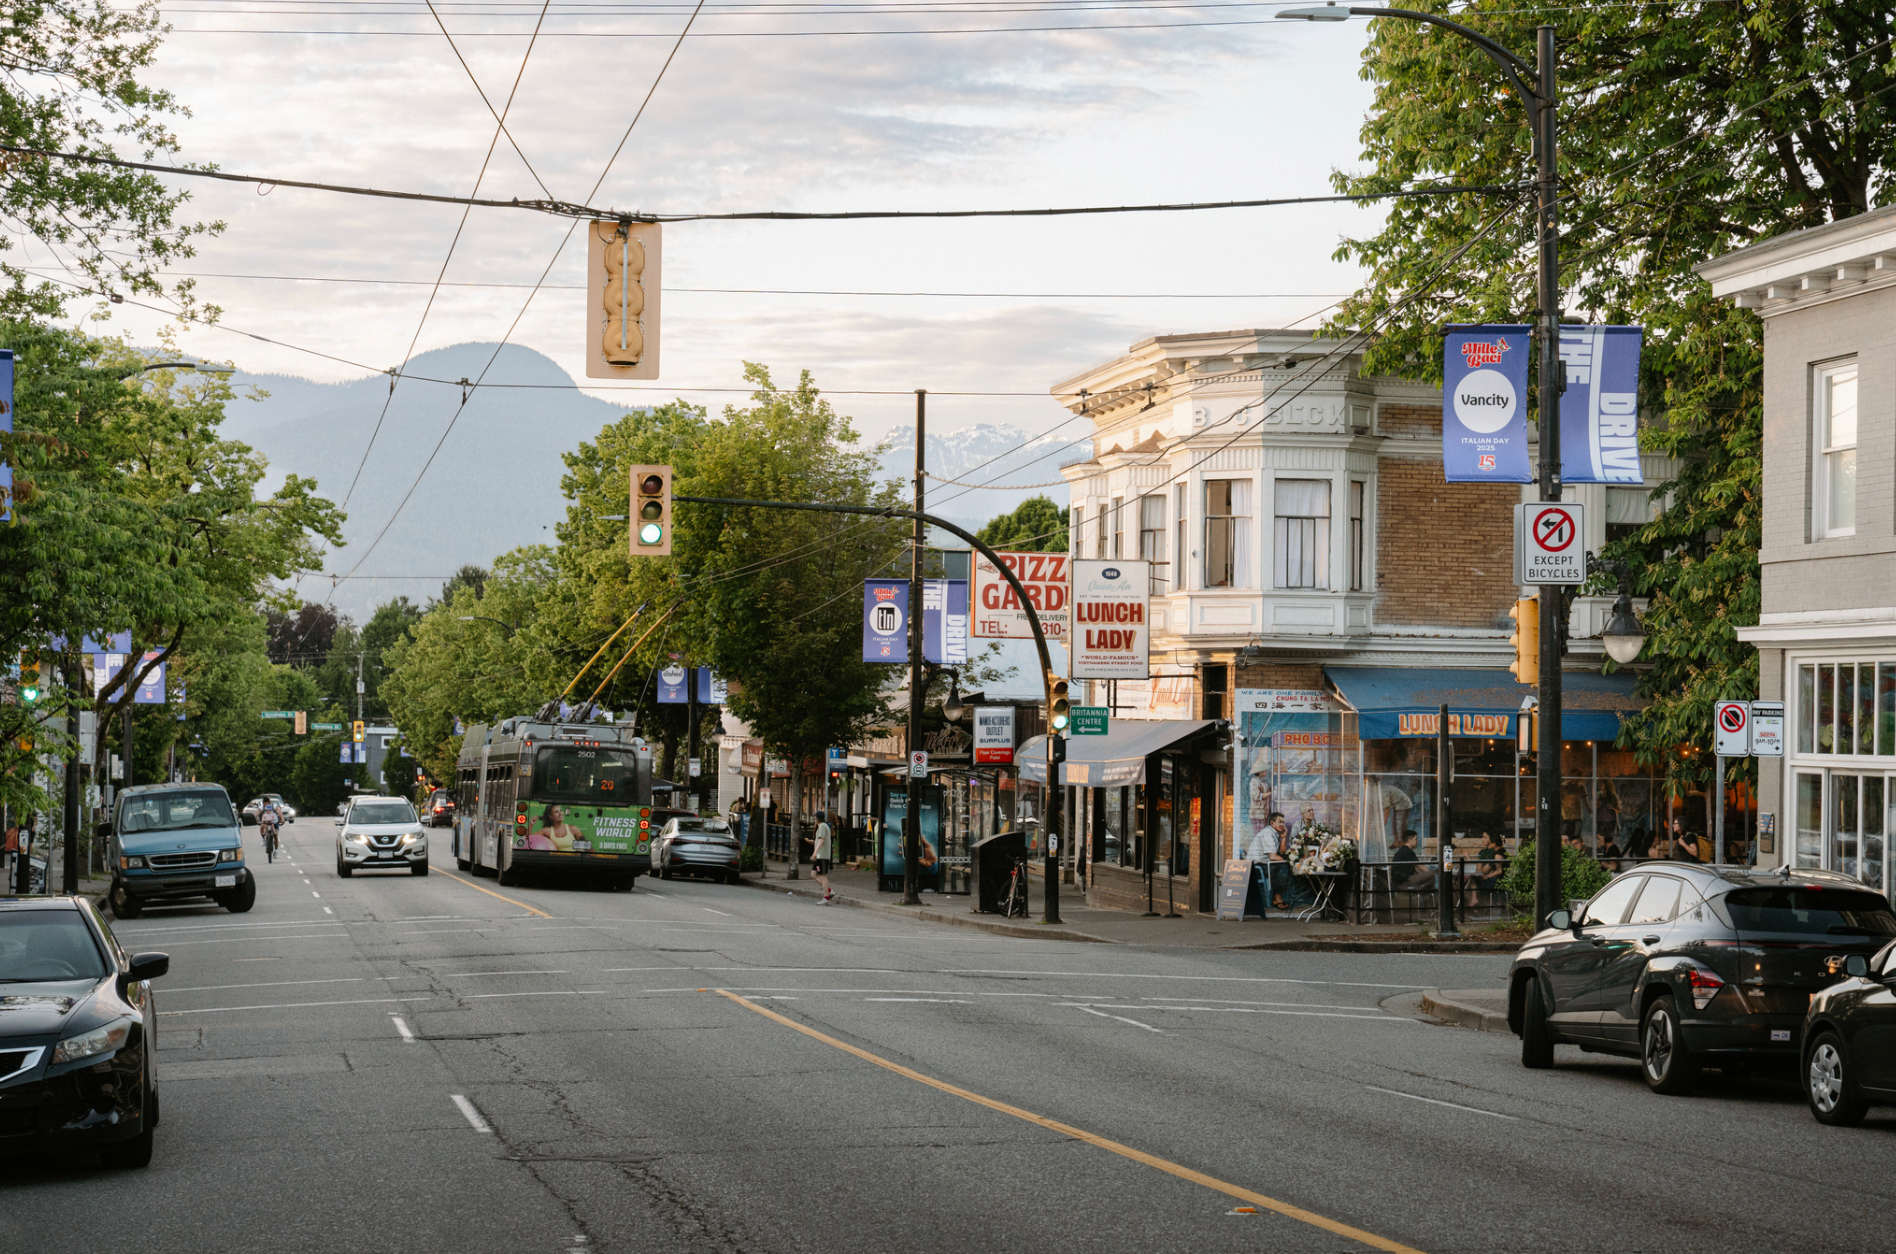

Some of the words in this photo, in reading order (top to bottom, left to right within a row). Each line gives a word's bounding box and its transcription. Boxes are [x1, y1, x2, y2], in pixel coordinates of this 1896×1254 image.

[1462, 342, 1498, 354] Mille
[1467, 352, 1502, 368] Baci
[1461, 394, 1508, 408] Vancity
[1600, 393, 1640, 481] DRIVE
[1534, 556, 1574, 565] EXCEPT
[999, 555, 1069, 582] PIZZ
[1529, 569, 1579, 578] BICYCLES
[1077, 602, 1145, 625] LUNCH
[980, 621, 1007, 634] TEL:
[1086, 630, 1137, 652] LADY
[986, 727, 1003, 735] OUTLET
[1463, 714, 1509, 736] LADY
[601, 780, 614, 790] 20
[593, 817, 636, 828] FITNESS
[596, 828, 632, 838] WORLD
